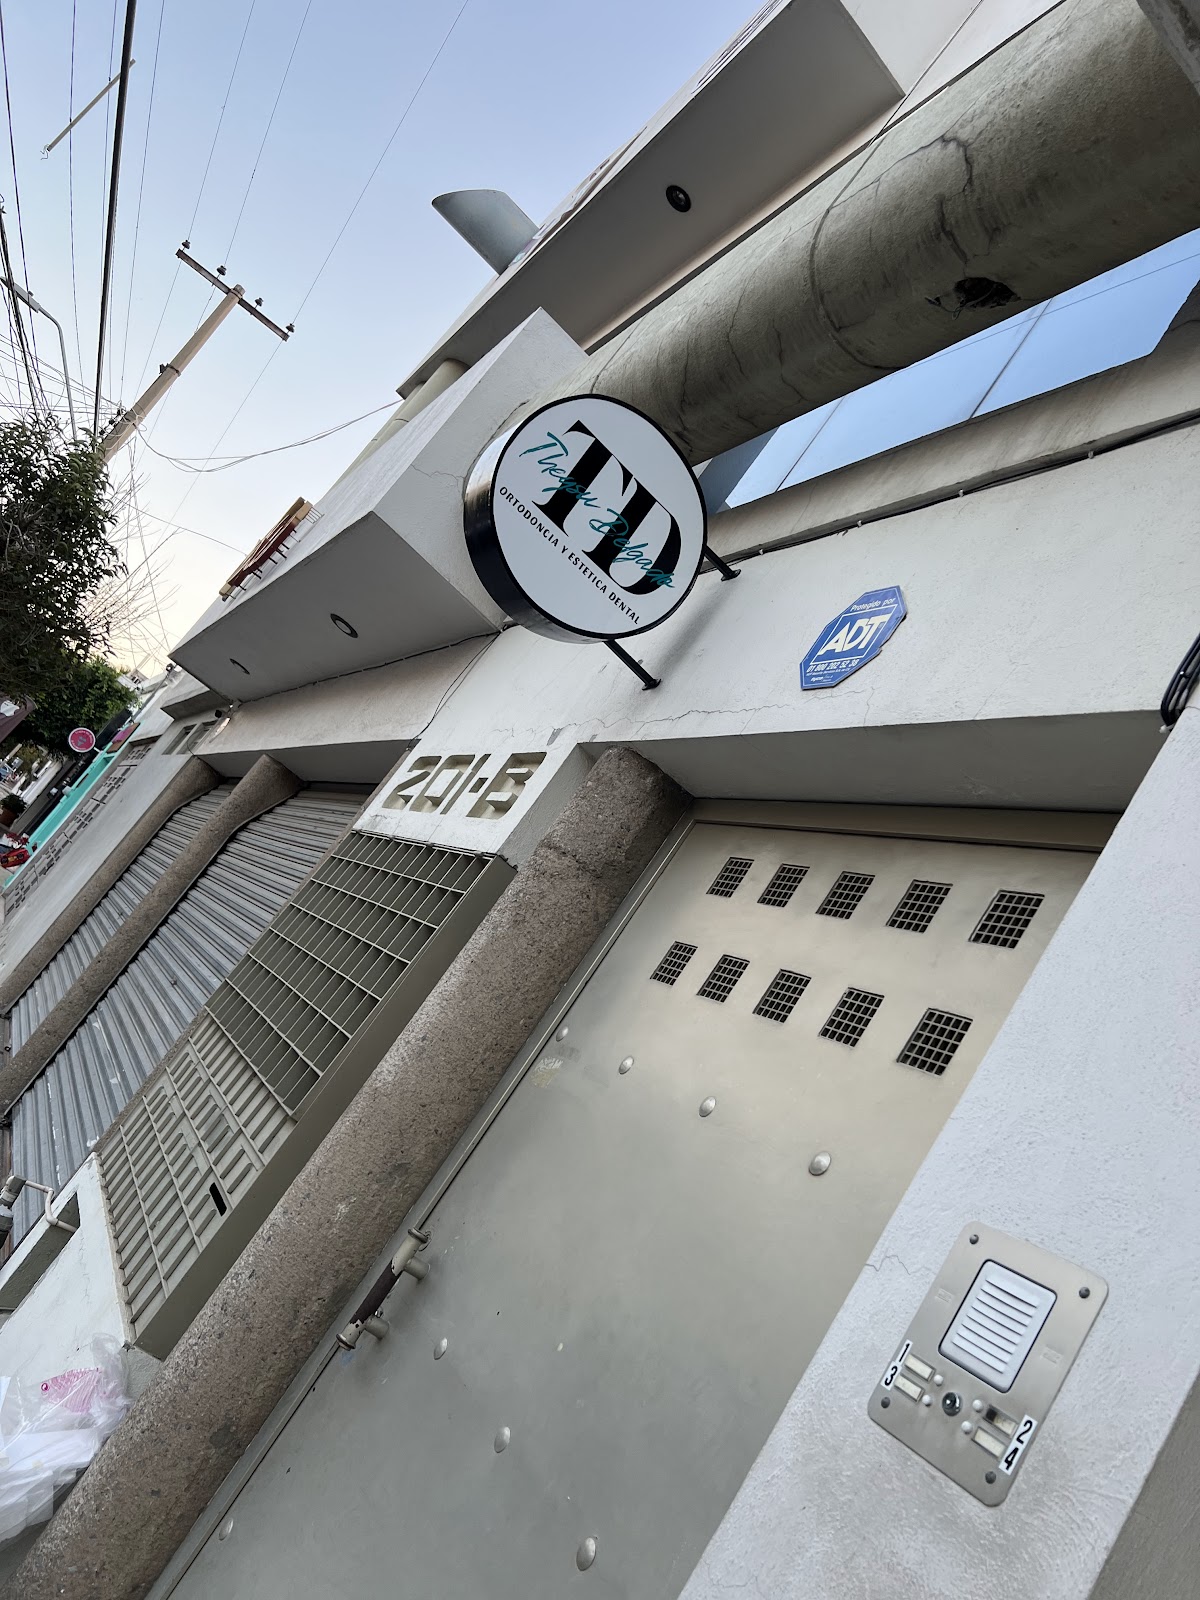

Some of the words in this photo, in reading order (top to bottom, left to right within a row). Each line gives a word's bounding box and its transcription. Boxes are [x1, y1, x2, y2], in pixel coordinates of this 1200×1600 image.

[499, 486, 559, 548] ORTODONCIA
[561, 546, 569, 555] Y
[567, 552, 607, 594] ESTETICA
[608, 591, 640, 625] DENTAL
[588, 508, 676, 589] Delgado
[851, 600, 881, 612] Protegido
[882, 598, 896, 606] por
[817, 613, 892, 656] ADT
[898, 1342, 910, 1364] 1
[884, 1365, 899, 1387] 3
[1015, 1419, 1033, 1445] 2
[1003, 1447, 1019, 1471] 4
